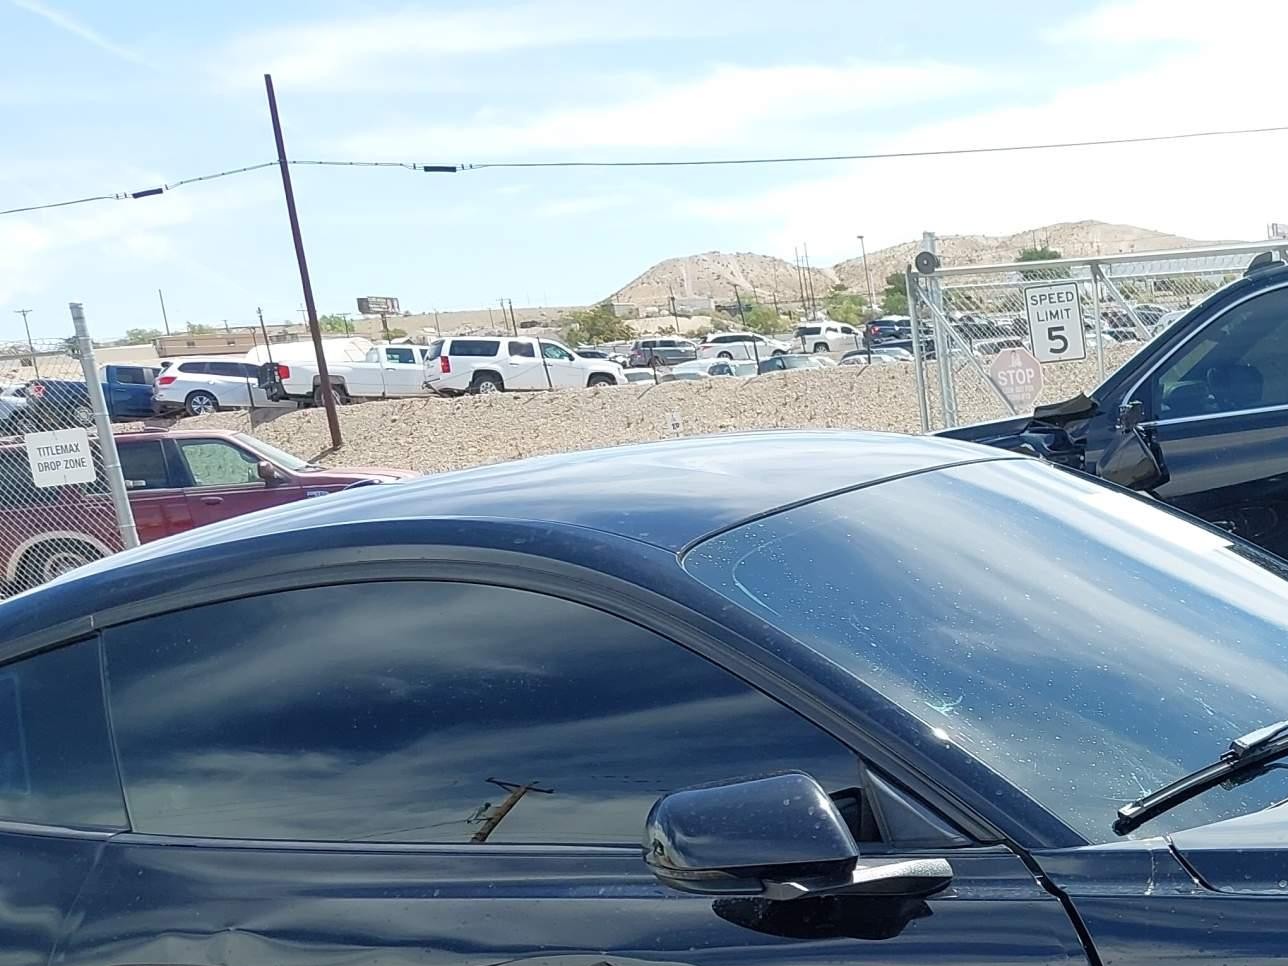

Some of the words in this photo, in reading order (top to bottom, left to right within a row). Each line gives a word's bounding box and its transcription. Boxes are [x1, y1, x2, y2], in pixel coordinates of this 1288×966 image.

[1030, 291, 1075, 306] SPEED
[1036, 308, 1072, 322] LIMIT
[1047, 325, 1069, 354] 5
[997, 368, 1035, 386] STOP
[36, 442, 81, 457] TITLEMAX
[37, 461, 62, 473] DROP
[63, 457, 88, 470] ZONE
